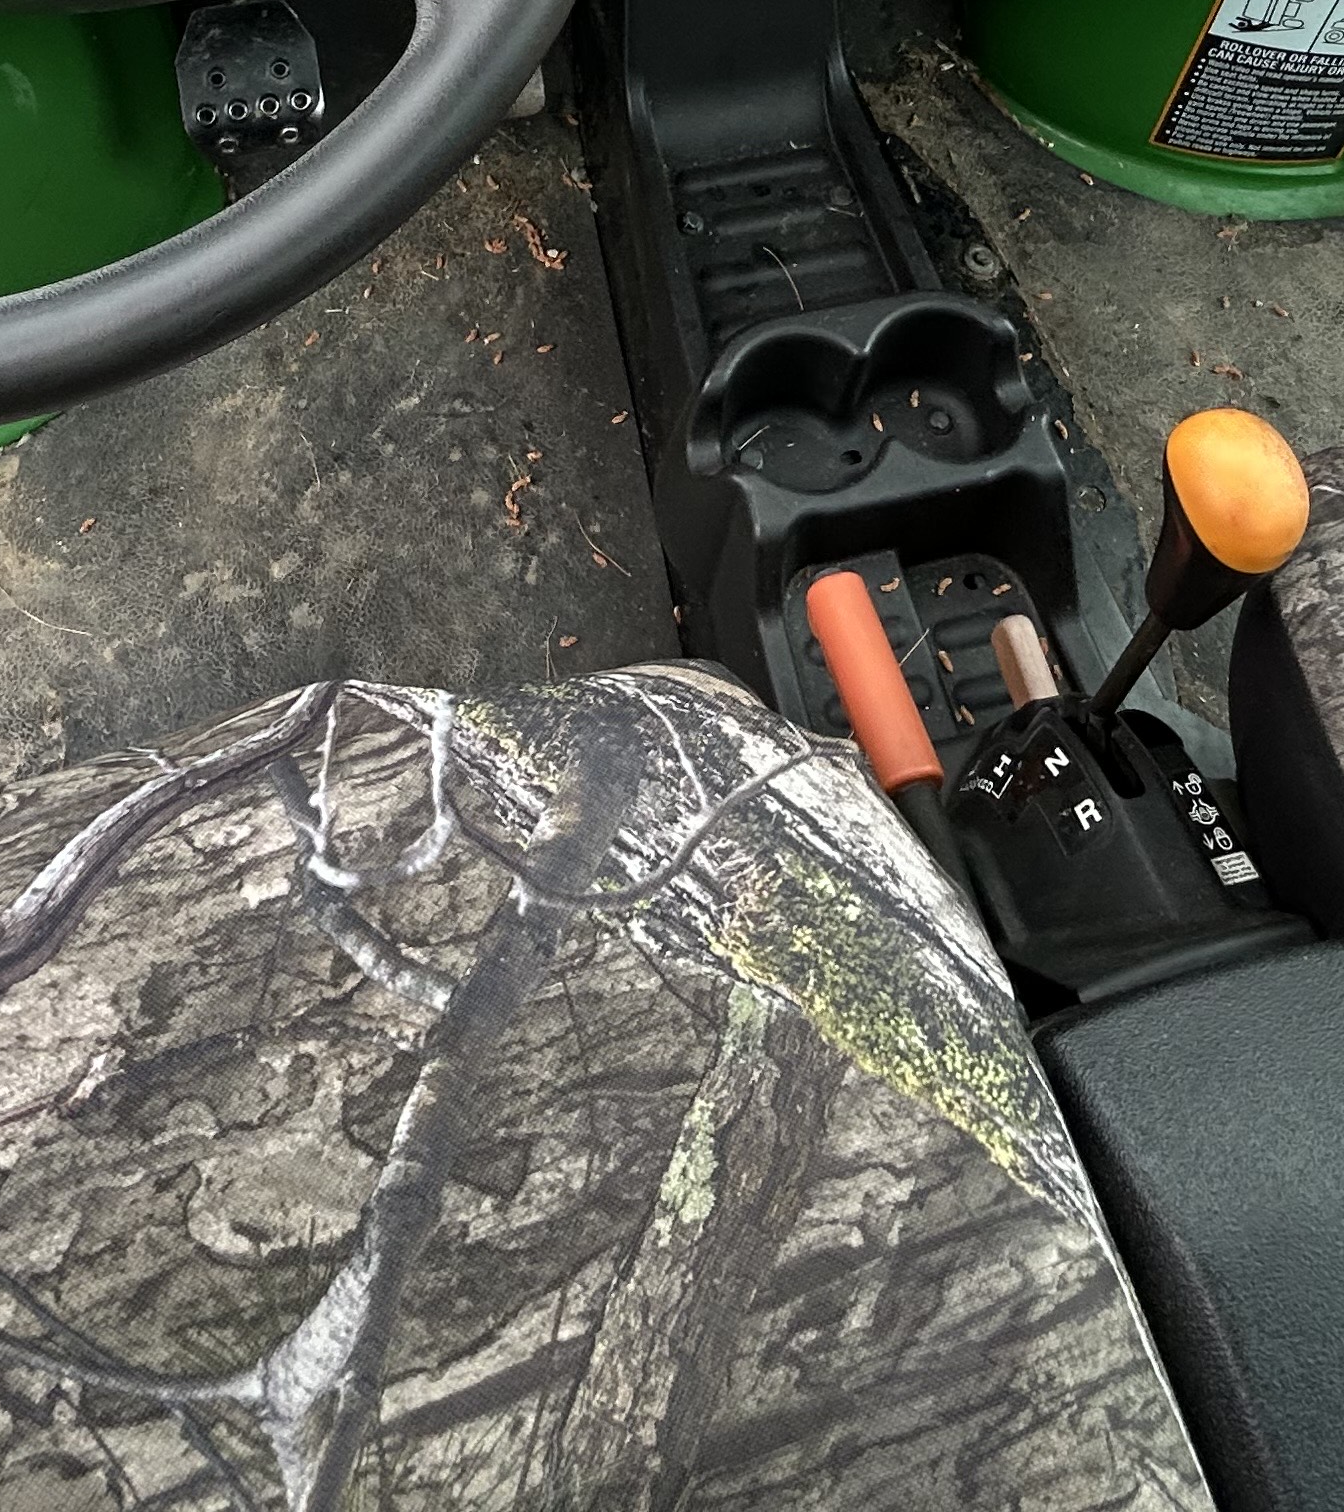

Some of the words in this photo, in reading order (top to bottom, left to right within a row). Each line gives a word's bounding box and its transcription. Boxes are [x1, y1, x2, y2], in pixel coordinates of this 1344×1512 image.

[1207, 47, 1234, 61] CAN
[1236, 53, 1278, 69] CAUSE
[1279, 61, 1325, 73] INJURY
[1219, 40, 1286, 60] ROLLOVER
[1288, 53, 1307, 63] OR
[993, 754, 1012, 778] H
[1044, 747, 1069, 777] N
[1074, 798, 1102, 831] R
